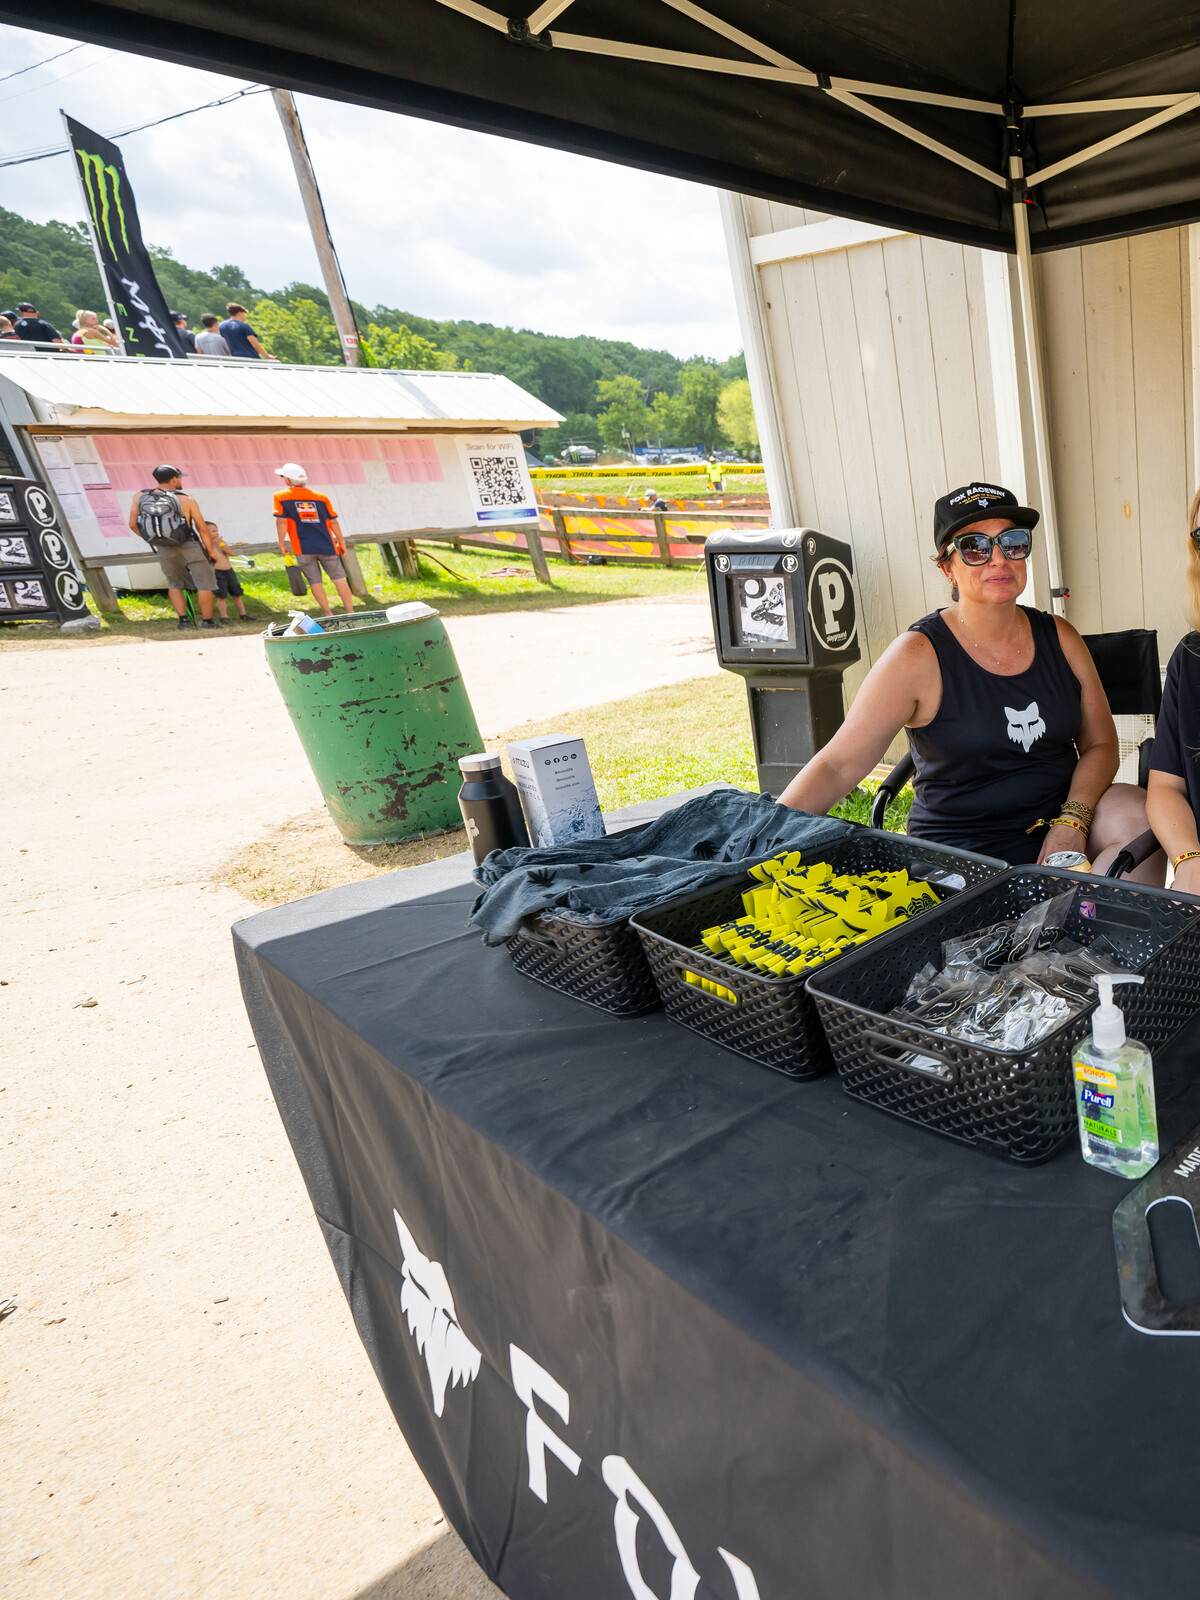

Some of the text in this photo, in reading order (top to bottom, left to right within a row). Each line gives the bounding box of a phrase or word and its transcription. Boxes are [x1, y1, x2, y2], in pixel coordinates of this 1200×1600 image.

[466, 443, 485, 451] Scan
[950, 493, 966, 506] FOX
[818, 571, 846, 635] P
[1084, 1089, 1112, 1108] Purell
[1084, 1119, 1118, 1137] NATURALS
